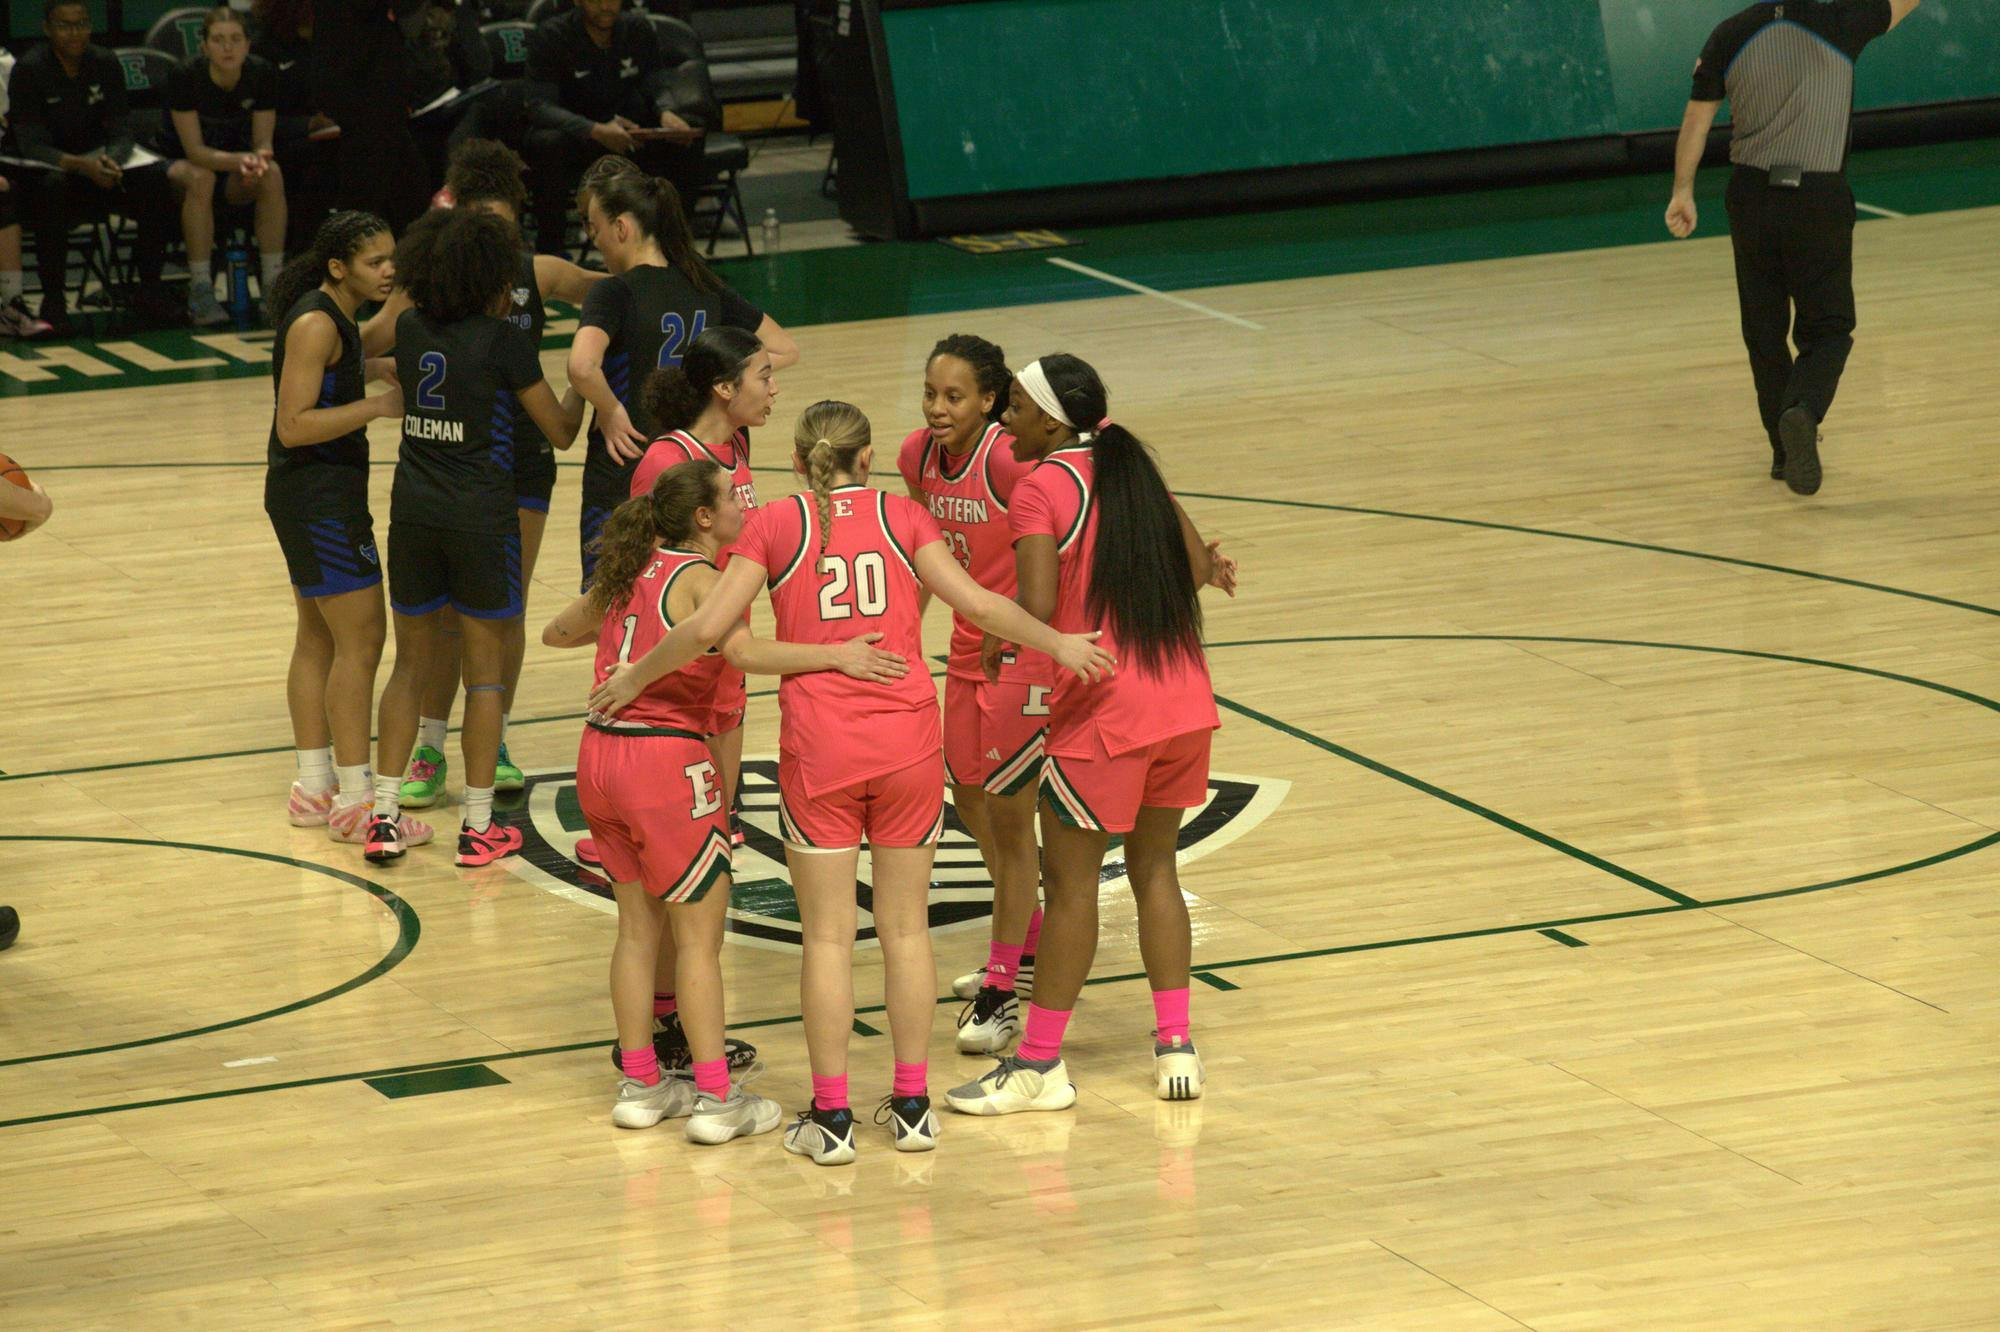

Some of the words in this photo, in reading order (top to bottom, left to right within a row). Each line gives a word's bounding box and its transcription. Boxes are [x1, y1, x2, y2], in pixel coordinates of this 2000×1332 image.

[416, 351, 447, 410] 2
[405, 413, 465, 443] COLEMAN
[831, 498, 854, 517] E
[925, 491, 990, 525] ASTERN
[815, 550, 888, 621] 20
[617, 613, 638, 664] 1
[684, 758, 723, 821] E
